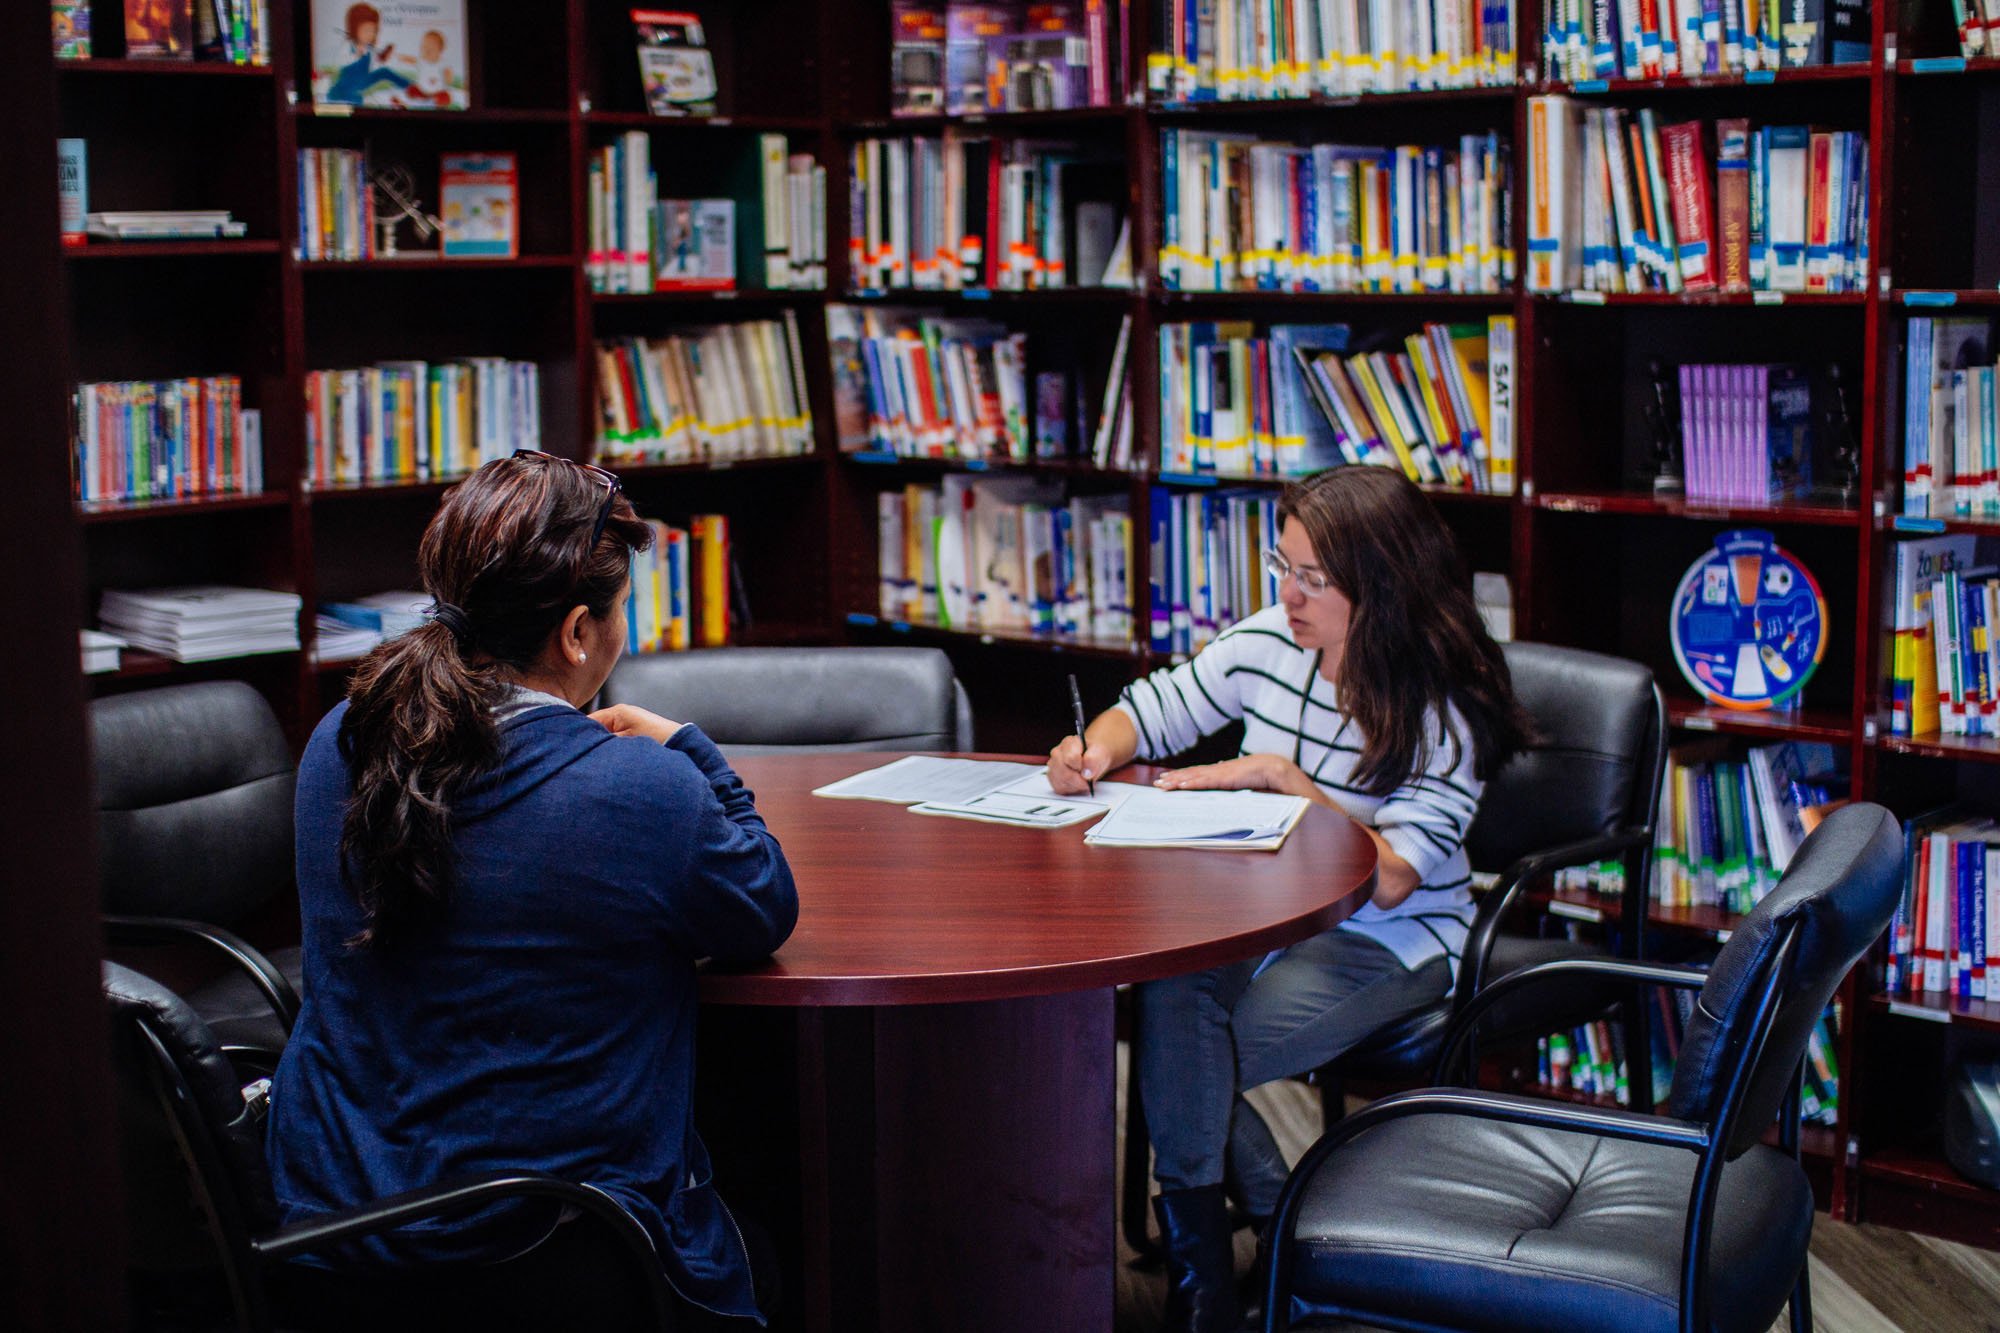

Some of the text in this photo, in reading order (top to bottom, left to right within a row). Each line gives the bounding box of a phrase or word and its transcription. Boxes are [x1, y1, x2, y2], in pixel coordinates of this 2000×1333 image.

[1494, 364, 1509, 411] SAT
[1974, 869, 1984, 886] The
[1972, 886, 1984, 939] Challenging
[1973, 939, 1984, 964] Child
